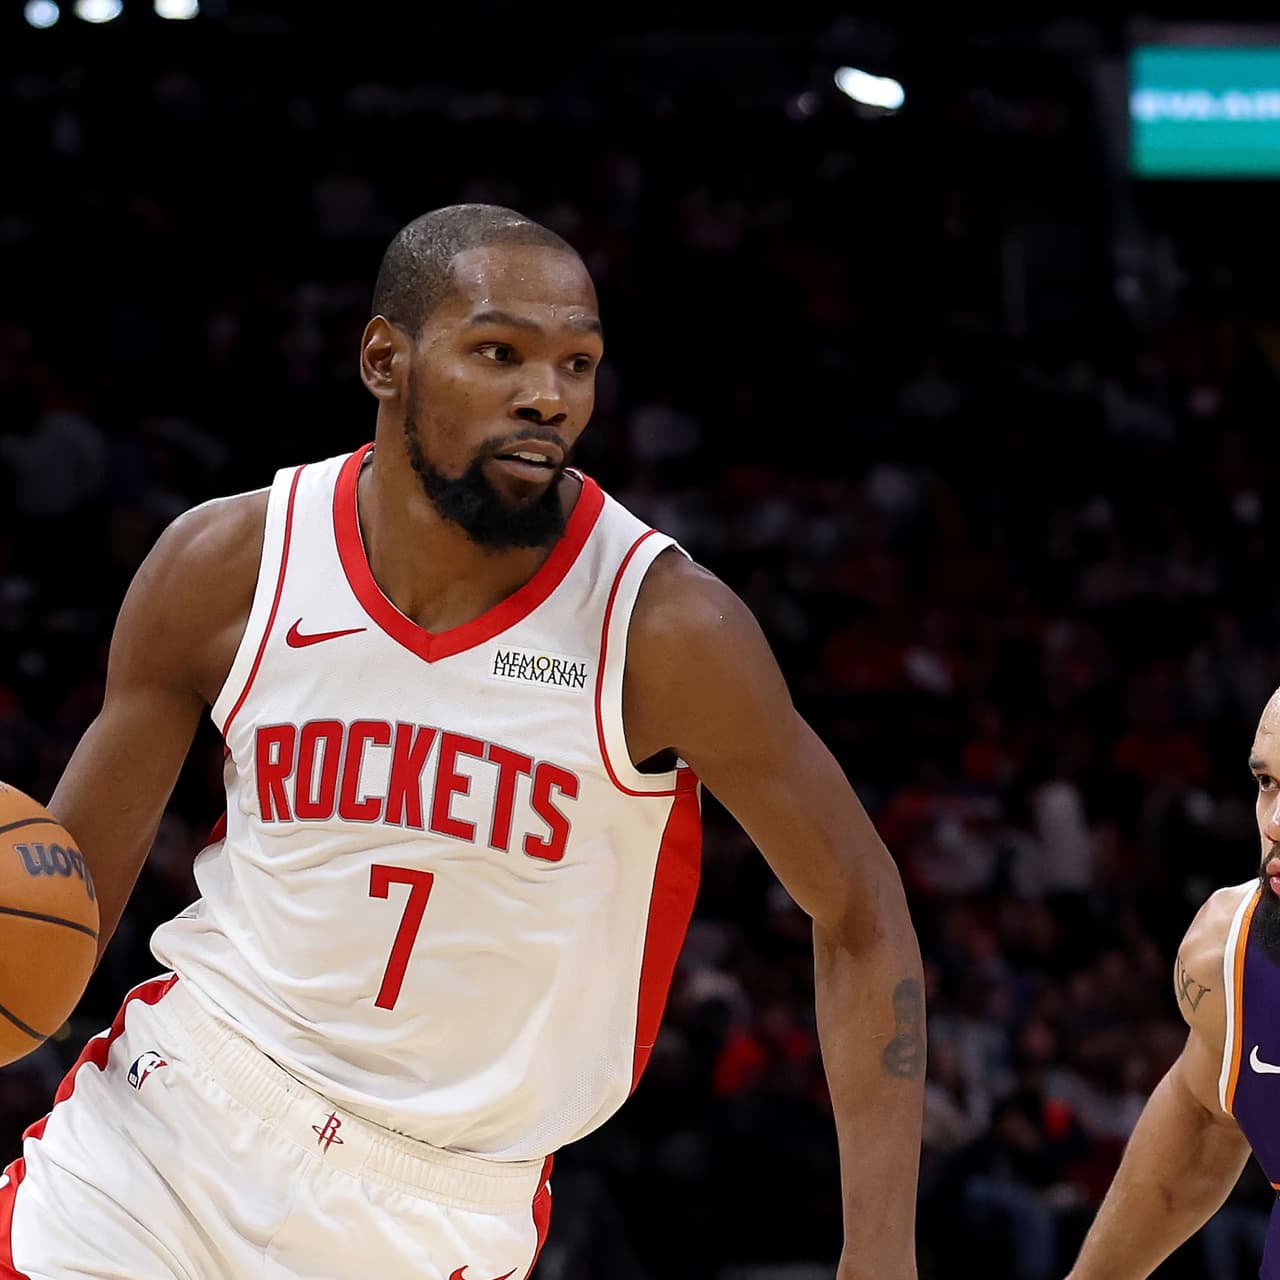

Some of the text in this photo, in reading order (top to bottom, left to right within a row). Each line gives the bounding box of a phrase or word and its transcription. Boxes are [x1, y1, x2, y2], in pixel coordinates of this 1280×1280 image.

[493, 662, 586, 688] HERMANN
[495, 650, 587, 677] MEMORIAL
[255, 719, 579, 862] ROCKETS
[369, 864, 434, 1011] 7
